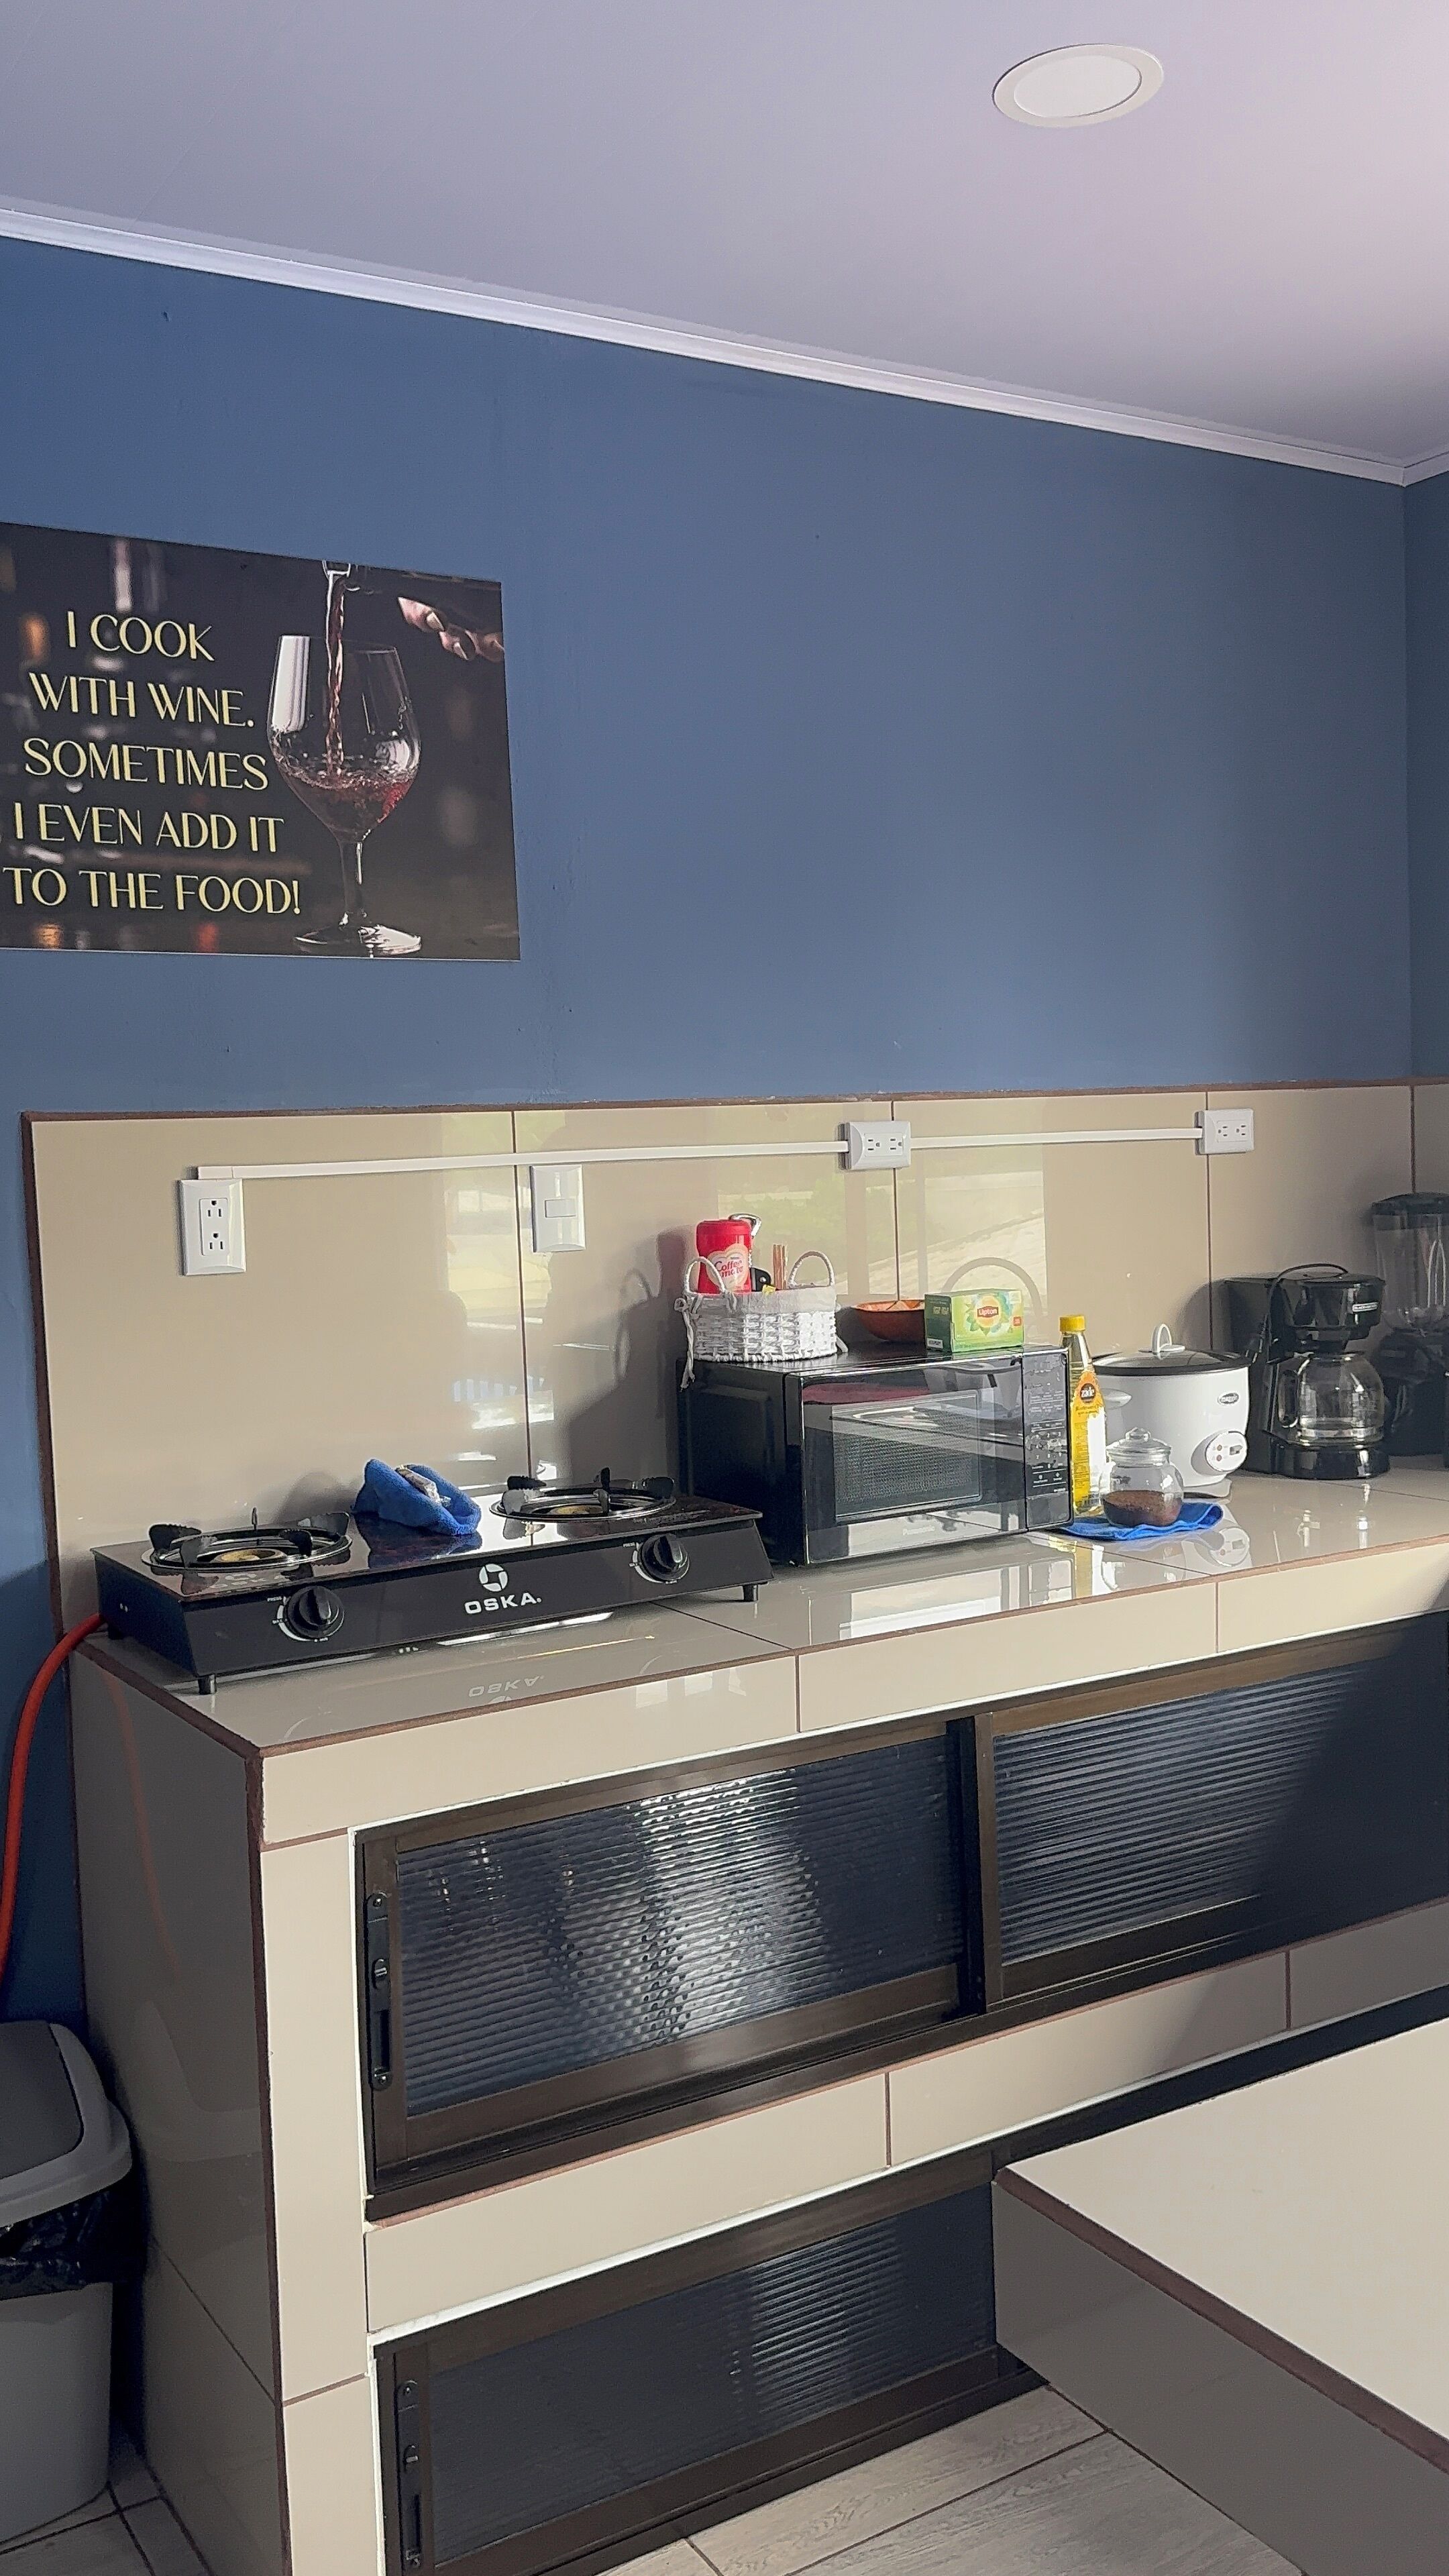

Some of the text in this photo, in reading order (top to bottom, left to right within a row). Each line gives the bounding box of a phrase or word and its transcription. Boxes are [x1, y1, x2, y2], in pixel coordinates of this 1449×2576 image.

[67, 610, 215, 661] I COOK
[29, 672, 254, 727] WITH WINE.
[24, 738, 268, 790] SOMETIMES
[14, 802, 284, 853] I EVEN ADD IT
[3, 867, 301, 915] TO THE FOOD!
[714, 1260, 743, 1271] Coffee
[978, 1308, 998, 1316] Lipton
